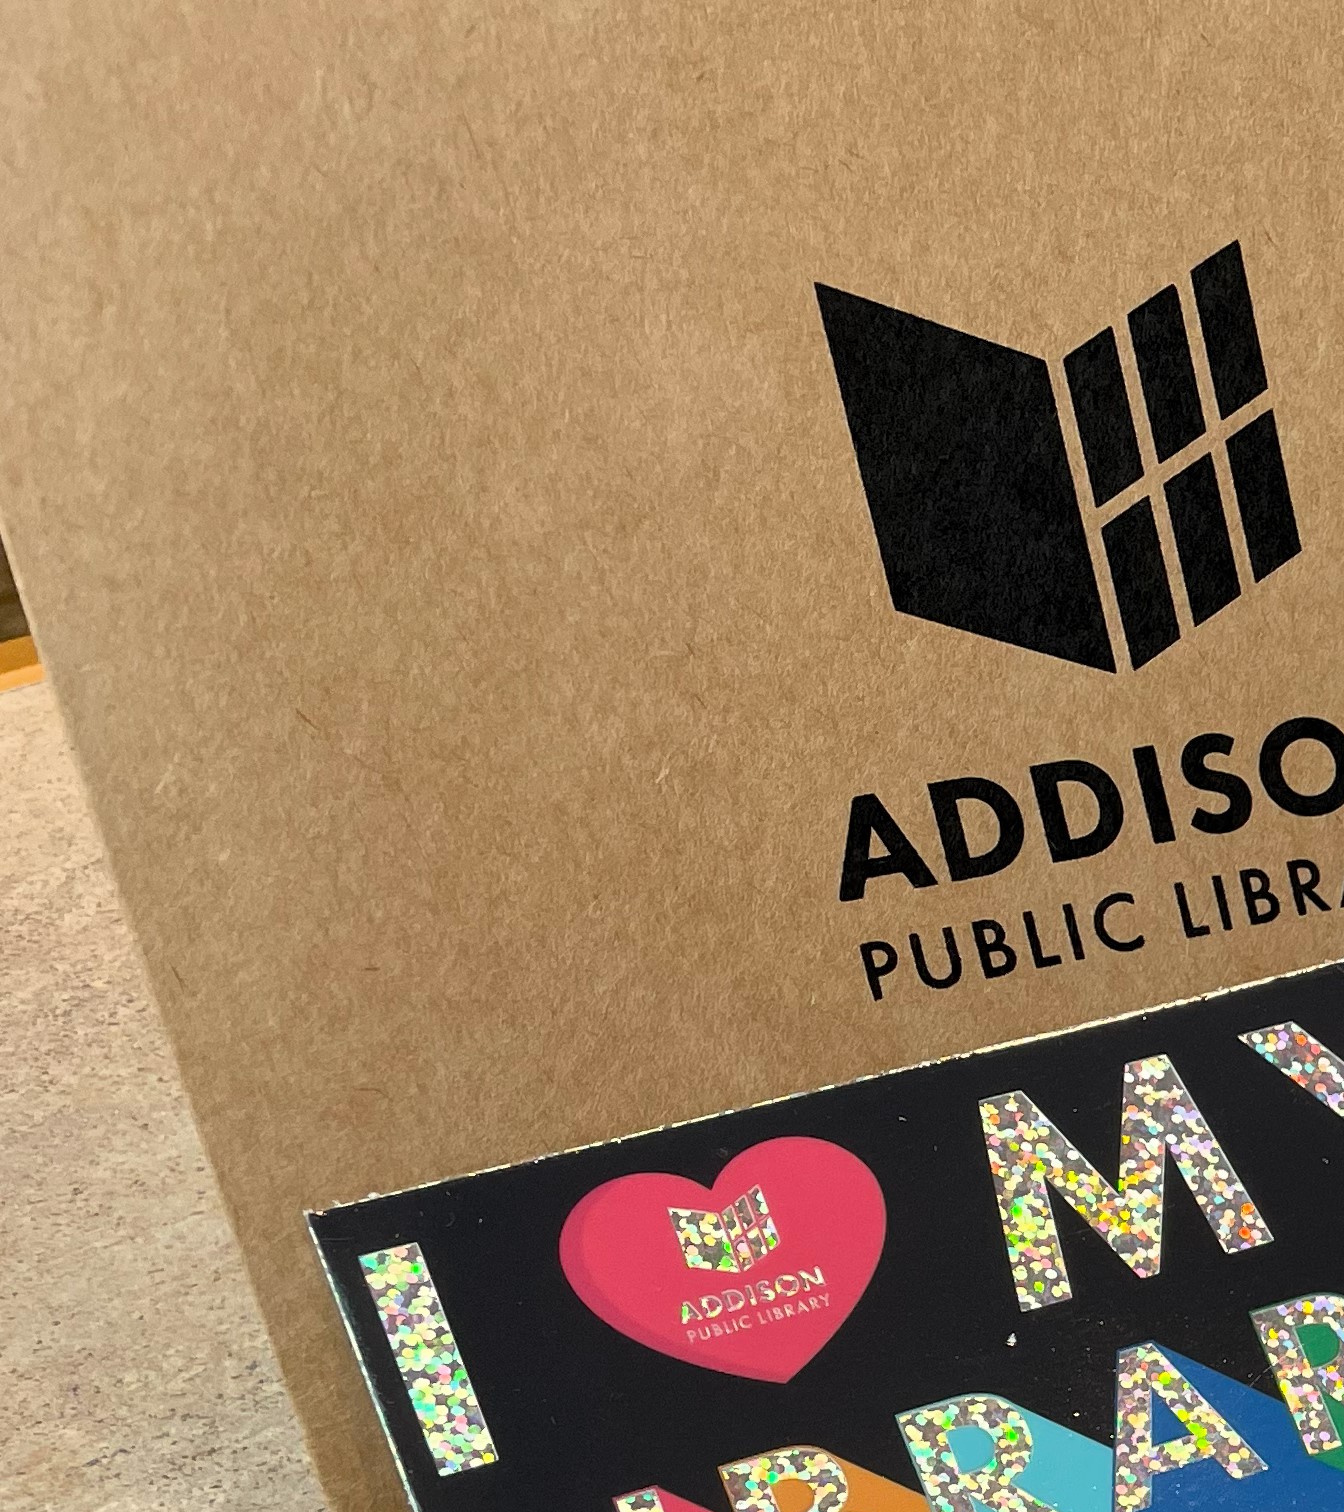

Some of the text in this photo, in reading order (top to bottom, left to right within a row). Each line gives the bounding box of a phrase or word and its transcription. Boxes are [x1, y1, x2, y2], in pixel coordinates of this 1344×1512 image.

[860, 893, 1145, 1001] PUBLIC
[680, 1265, 826, 1325] ADDISON
[686, 1294, 831, 1343] PUBLIC LIBRARY
[358, 1242, 499, 1477] I
